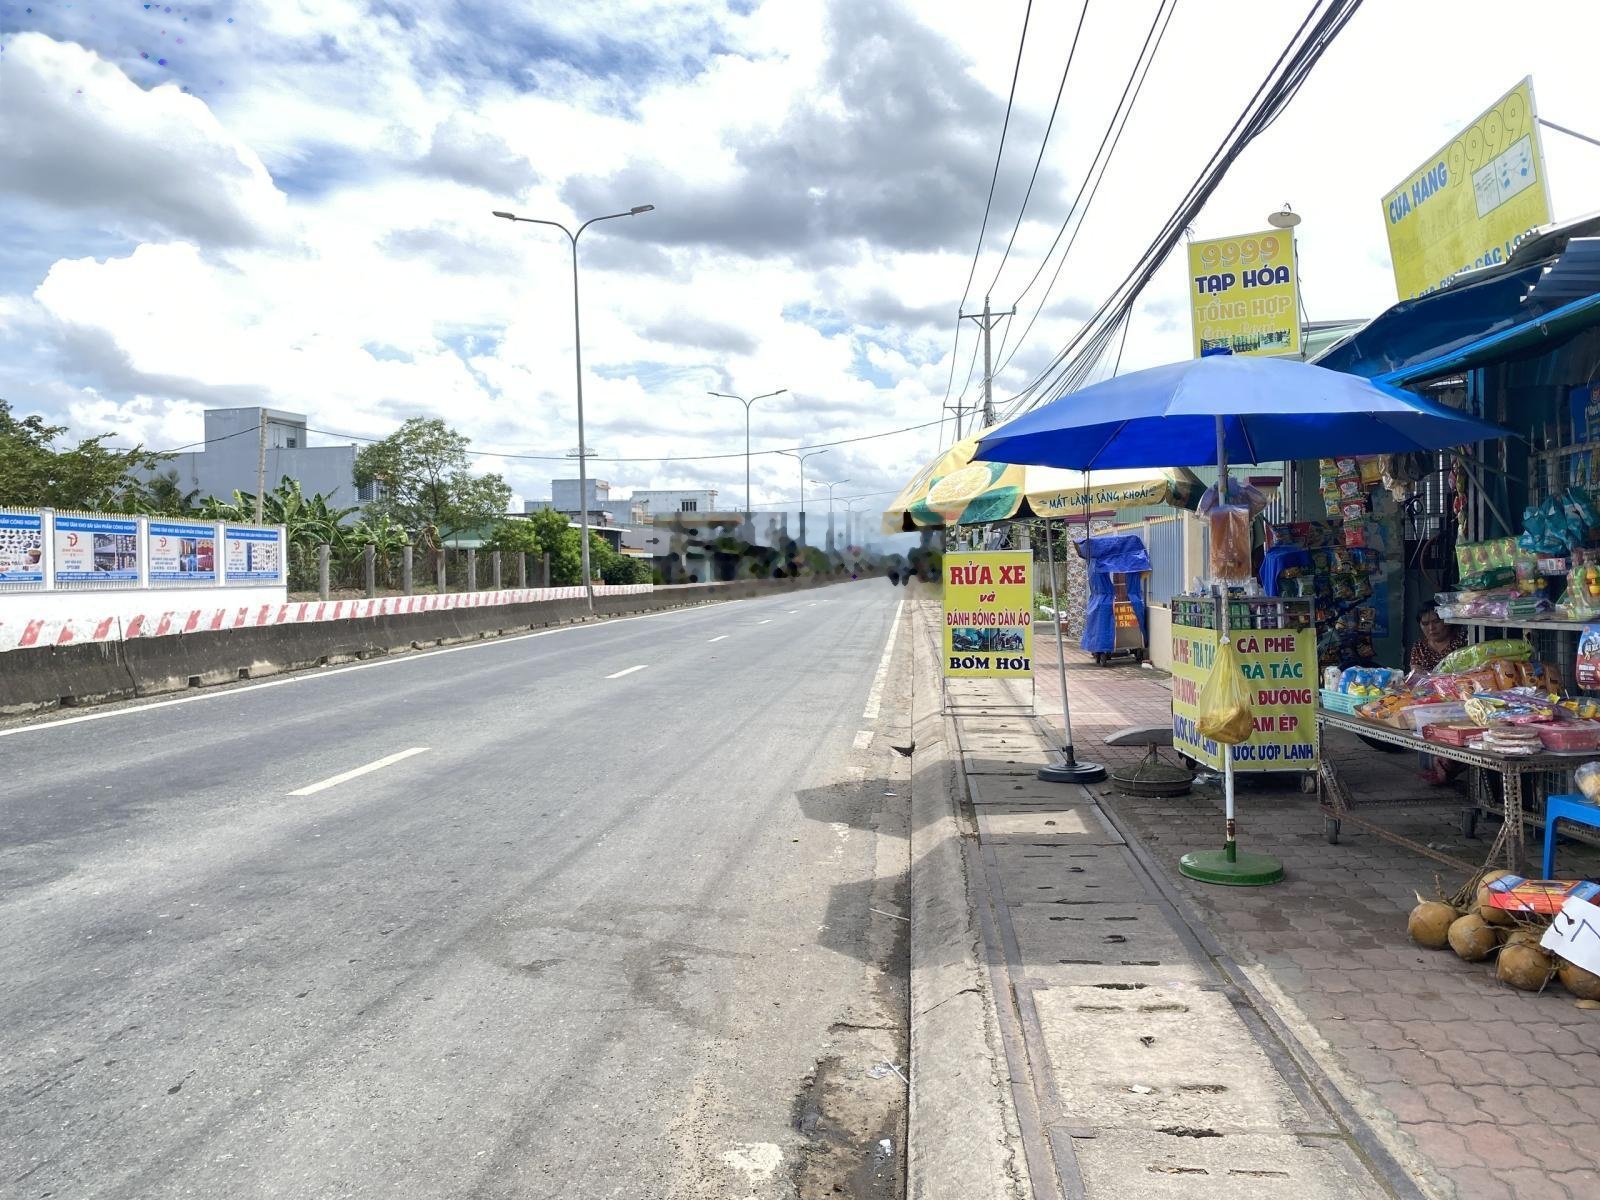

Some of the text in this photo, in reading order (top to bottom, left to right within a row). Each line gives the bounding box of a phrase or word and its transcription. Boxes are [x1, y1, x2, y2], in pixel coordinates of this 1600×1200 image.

[1411, 161, 1448, 208] HÀNG
[1448, 92, 1524, 188] 9999
[1201, 237, 1279, 270] 9999
[1195, 264, 1290, 296] TẠP HÓA
[1252, 296, 1291, 320] HỢP
[1049, 494, 1068, 509] MÁT
[1096, 489, 1120, 504] SẢNG
[950, 561, 1026, 585] RỬA XE
[979, 591, 995, 602] và
[947, 608, 1030, 626] ĐÁNH BÓNG DÀN ÁO
[1236, 634, 1296, 654] CÀ PHÊ
[949, 655, 1031, 670] BƠM HƠI
[1240, 658, 1303, 679] RÀ TẮC
[1258, 686, 1312, 705] ĐƯỜNG
[1252, 714, 1299, 732] AM ÉP
[1232, 742, 1256, 761] ƯỚC
[1284, 744, 1314, 763] LẠNH
